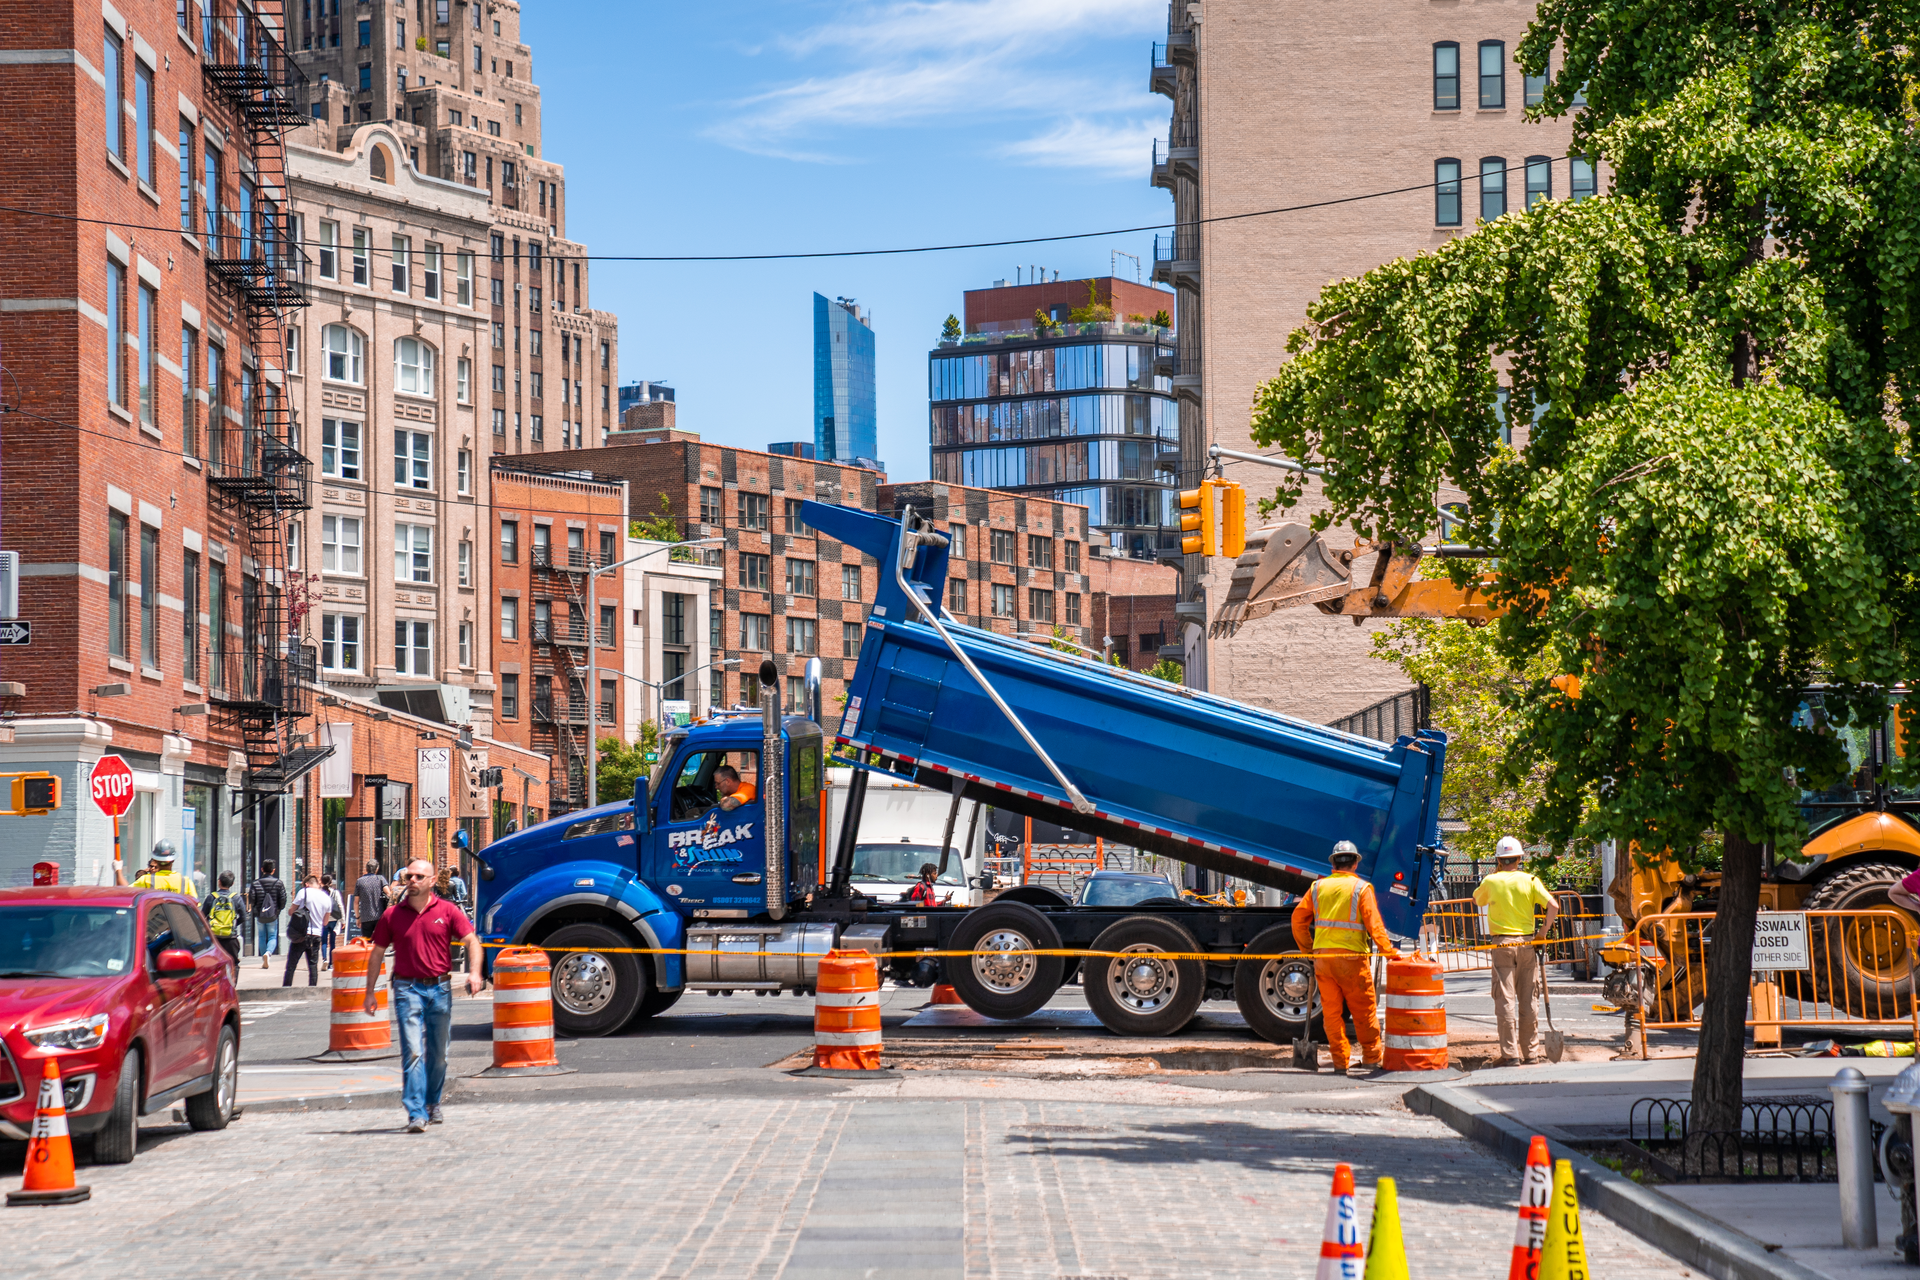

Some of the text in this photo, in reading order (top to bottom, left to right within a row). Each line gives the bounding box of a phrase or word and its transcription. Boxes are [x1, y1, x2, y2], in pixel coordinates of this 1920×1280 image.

[0, 628, 21, 638] WAY
[93, 773, 132, 799] STOP
[469, 753, 479, 811] MARNI
[47, 783, 55, 803] 3
[421, 809, 447, 817] SALON
[669, 823, 754, 850] BREAK
[679, 848, 744, 862] & RUN
[712, 896, 733, 904] USDOT
[1755, 920, 1801, 932] SSWALK
[1753, 936, 1789, 948] LOSED
[1754, 952, 1802, 962] OTHER SIDE
